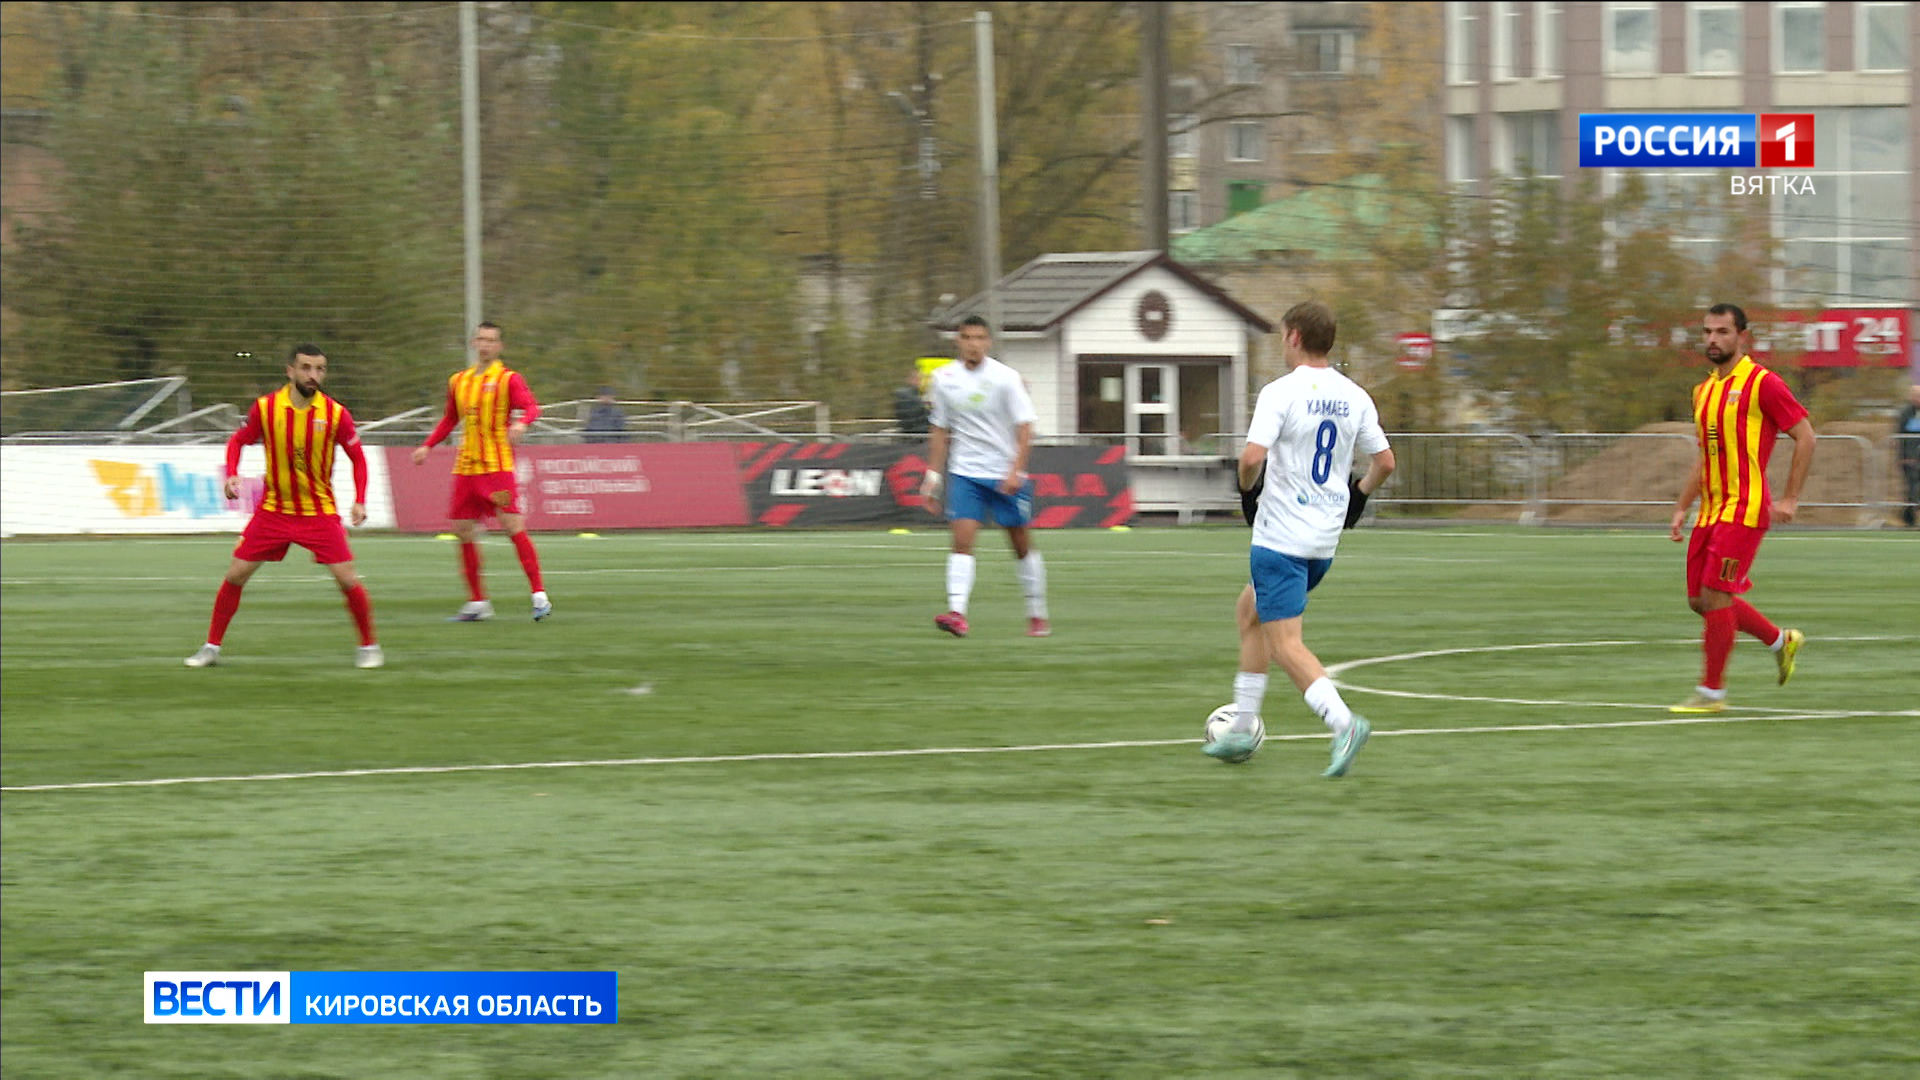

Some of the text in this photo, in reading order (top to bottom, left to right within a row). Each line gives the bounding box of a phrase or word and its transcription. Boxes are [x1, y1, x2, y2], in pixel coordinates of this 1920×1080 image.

[1853, 317, 1902, 342] 24
[1306, 399, 1349, 418] КАМАЕВ
[1311, 419, 1338, 485] 8
[770, 468, 883, 498] LEON
